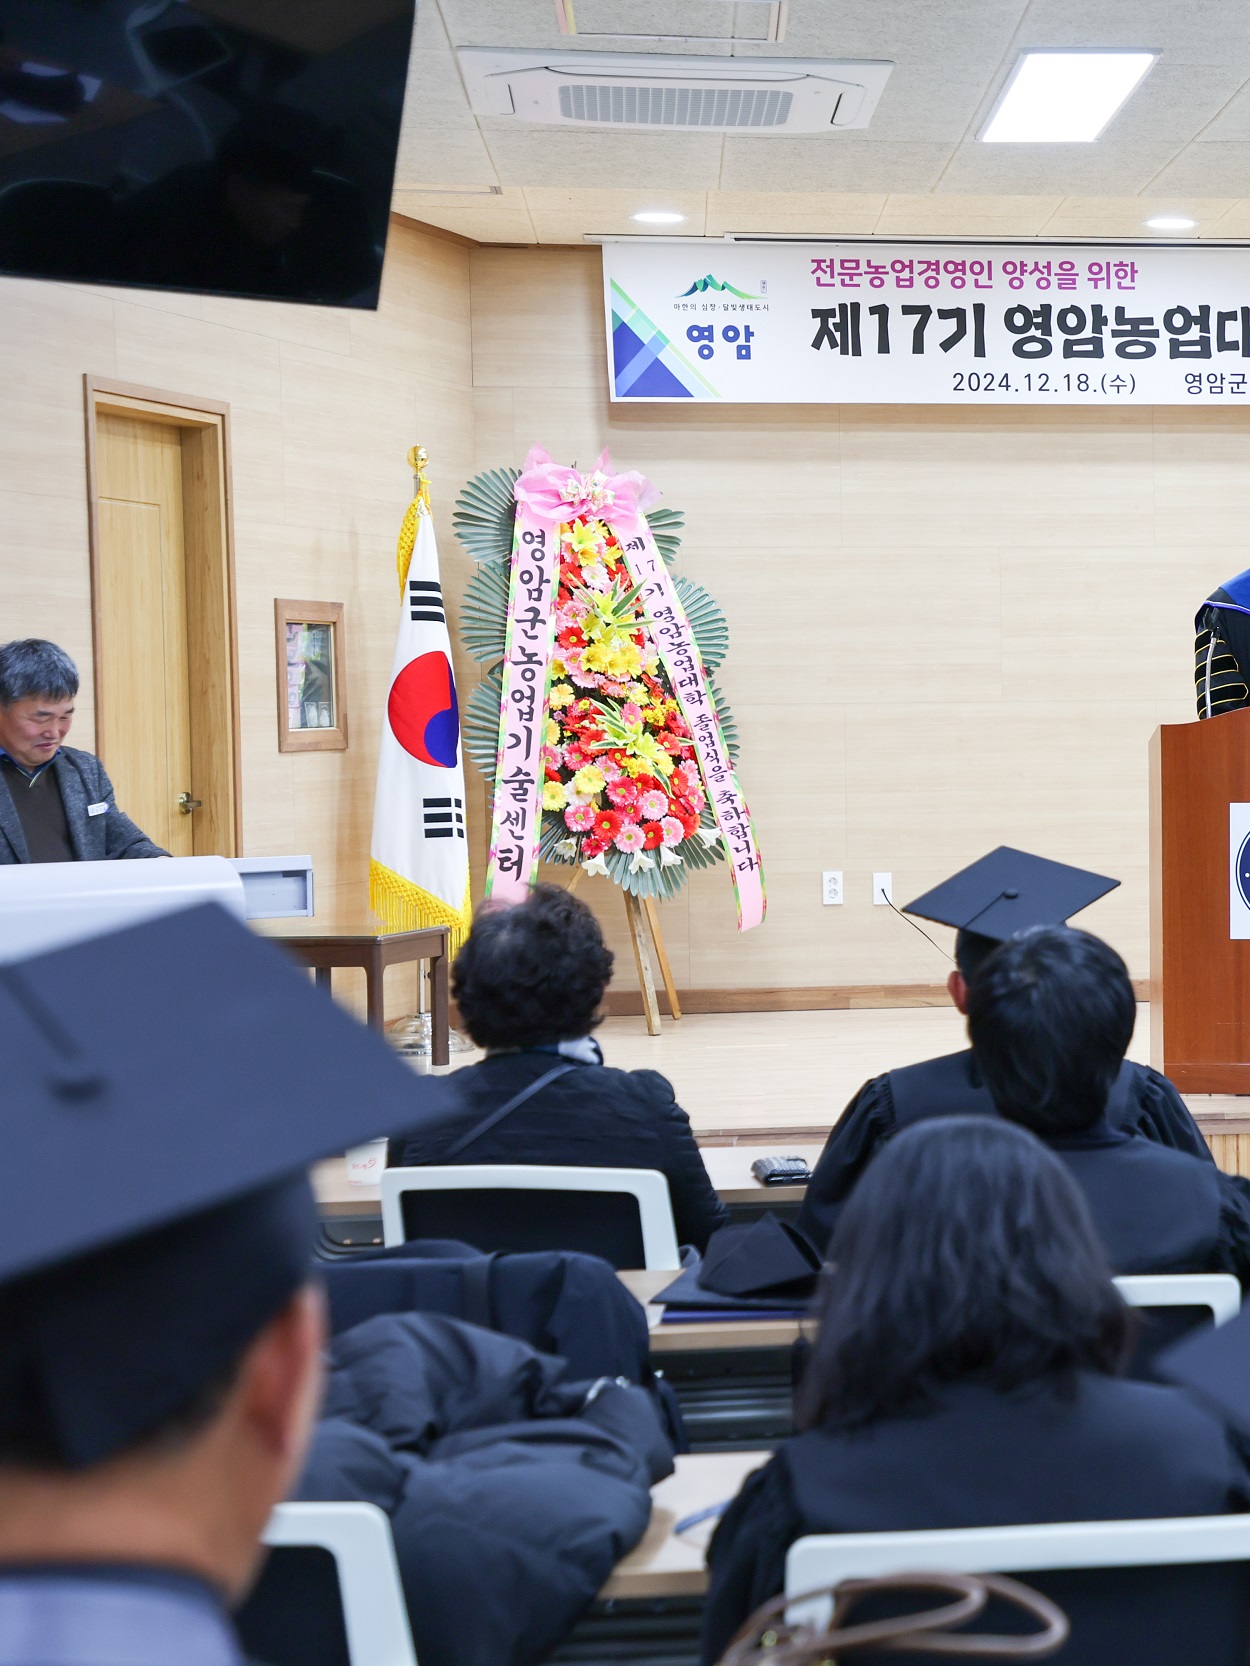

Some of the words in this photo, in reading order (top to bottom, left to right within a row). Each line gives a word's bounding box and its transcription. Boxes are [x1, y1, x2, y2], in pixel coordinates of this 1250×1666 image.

[810, 258, 994, 290] 전문농업경영인
[1002, 259, 1080, 290] 양성을
[1087, 260, 1138, 291] 위한
[673, 303, 697, 311] 마한의
[686, 324, 755, 360] 영암
[811, 301, 987, 358] 제17기
[952, 371, 1137, 394] 2024.12.18.(수)
[497, 528, 551, 882] 영암군농업기술센터
[653, 606, 706, 706] 영암농업대학
[694, 713, 727, 783] 졸업식을
[716, 789, 760, 873] 축하합니다
